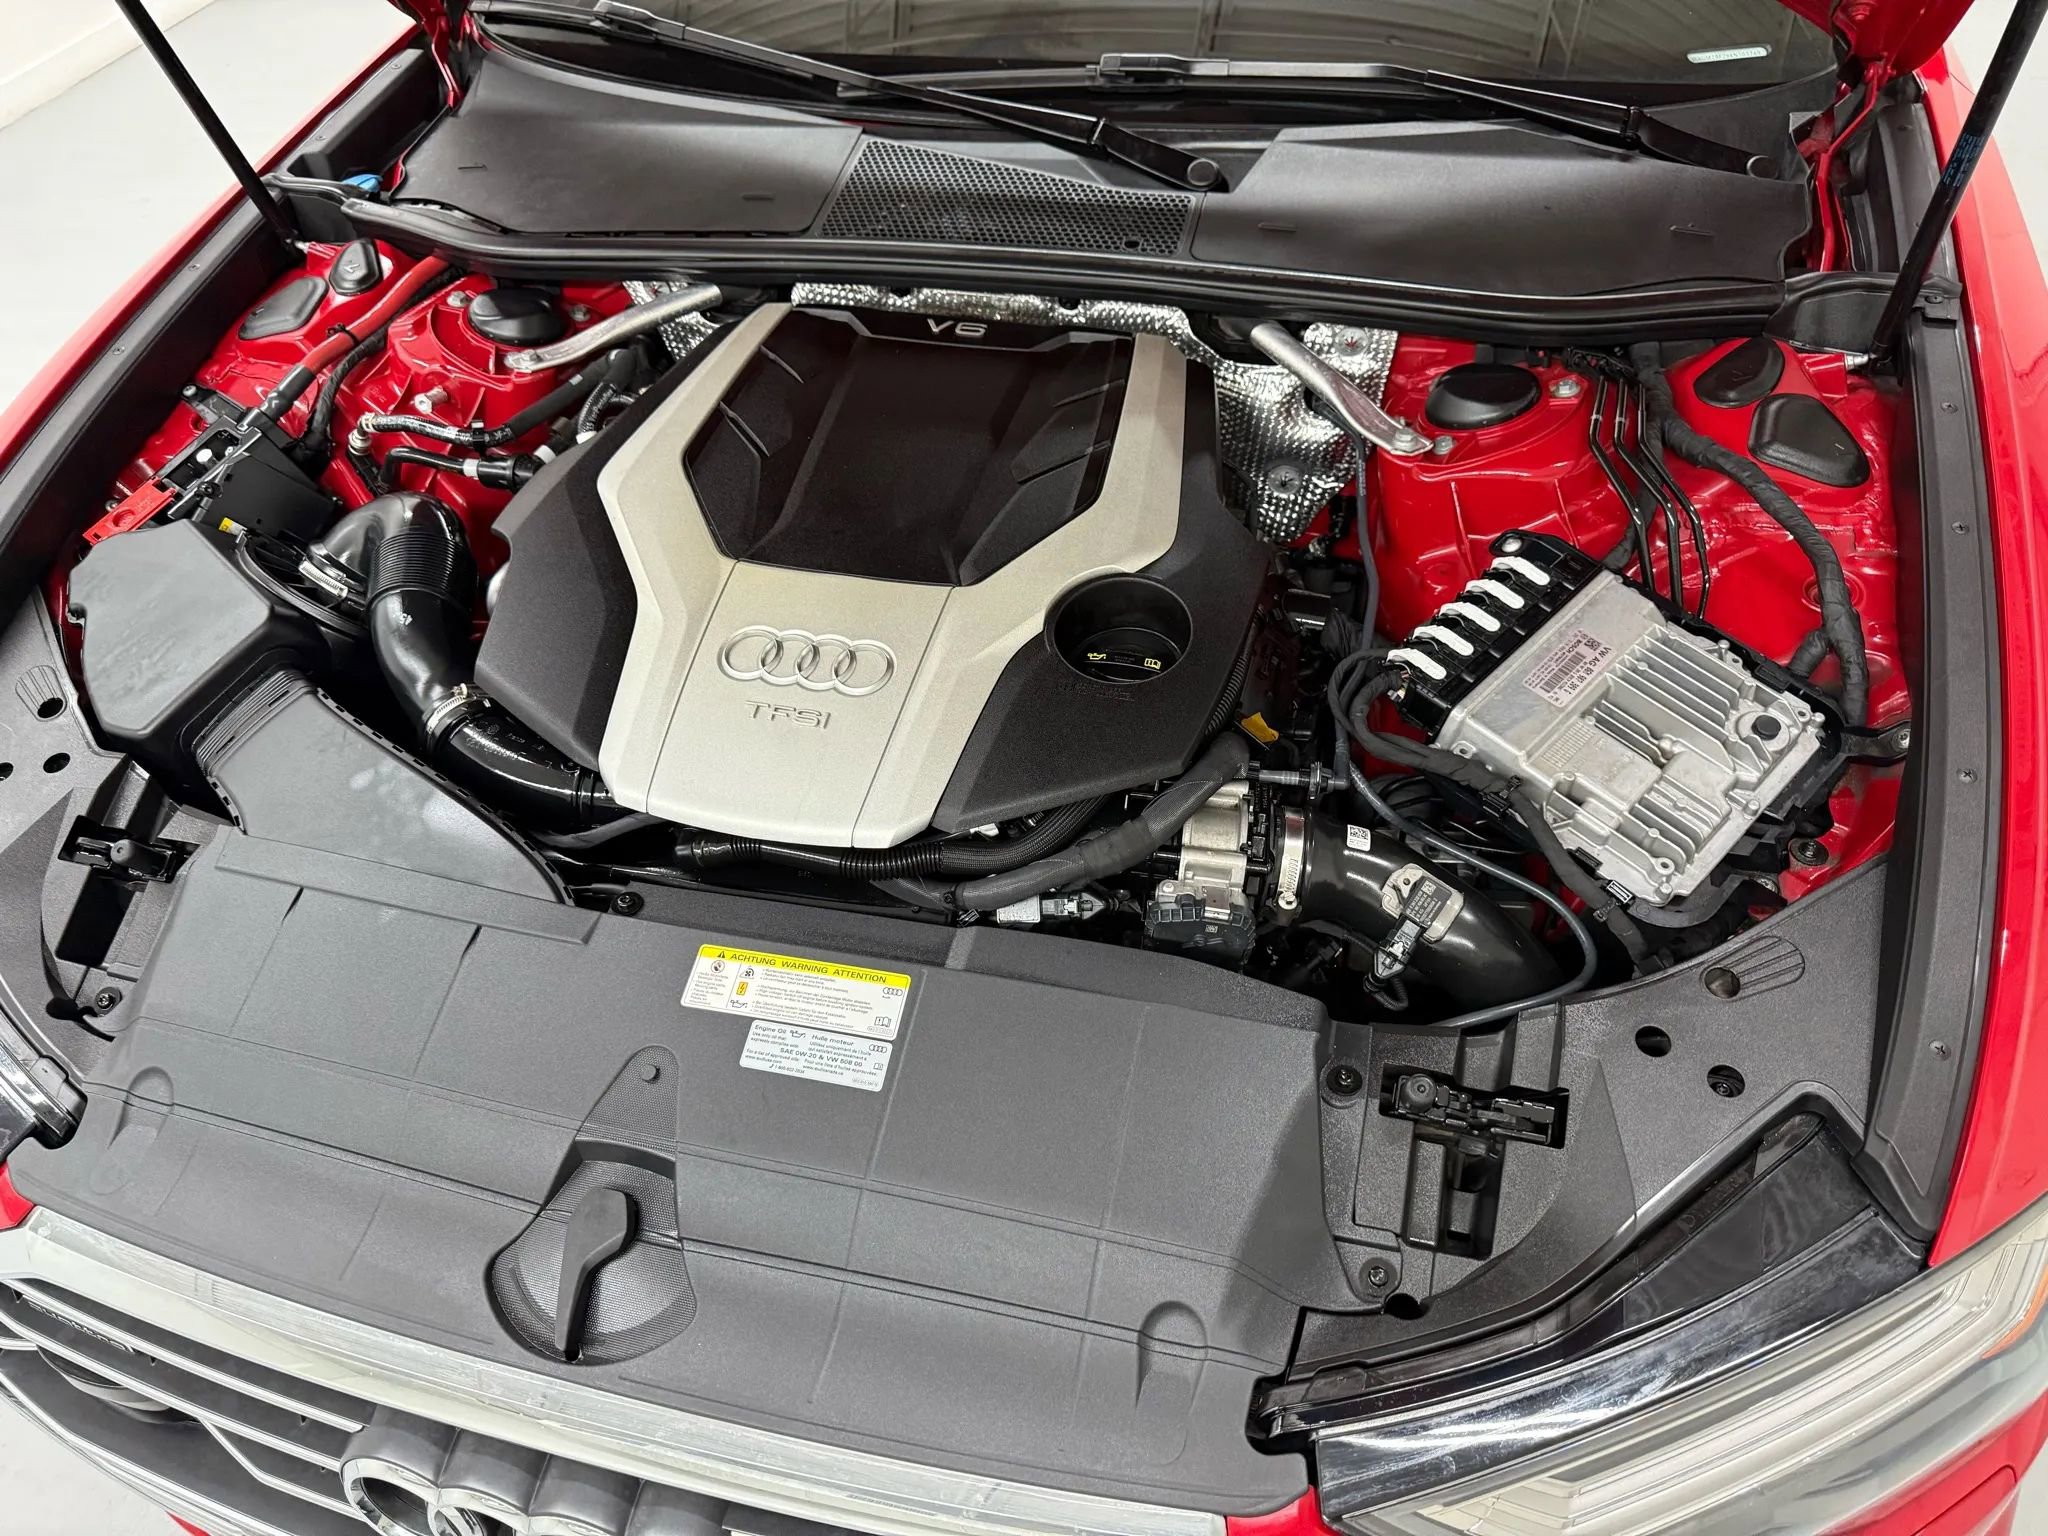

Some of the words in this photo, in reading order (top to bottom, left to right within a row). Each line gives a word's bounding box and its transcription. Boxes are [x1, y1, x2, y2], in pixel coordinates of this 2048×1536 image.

[927, 318, 988, 336] V6
[1565, 639, 1582, 654] BOSCH
[1597, 646, 1612, 658] VW
[1587, 656, 1601, 667] AG
[744, 700, 832, 729] TFSI
[730, 953, 777, 966] ACHTUNG
[781, 960, 829, 974] WARNING
[832, 968, 887, 983] ATTENTION
[754, 1024, 776, 1033] Engine
[811, 1034, 828, 1042] Huile
[829, 1037, 854, 1046] moteur
[780, 1047, 794, 1055] SAE
[794, 1050, 817, 1059] 0W-20
